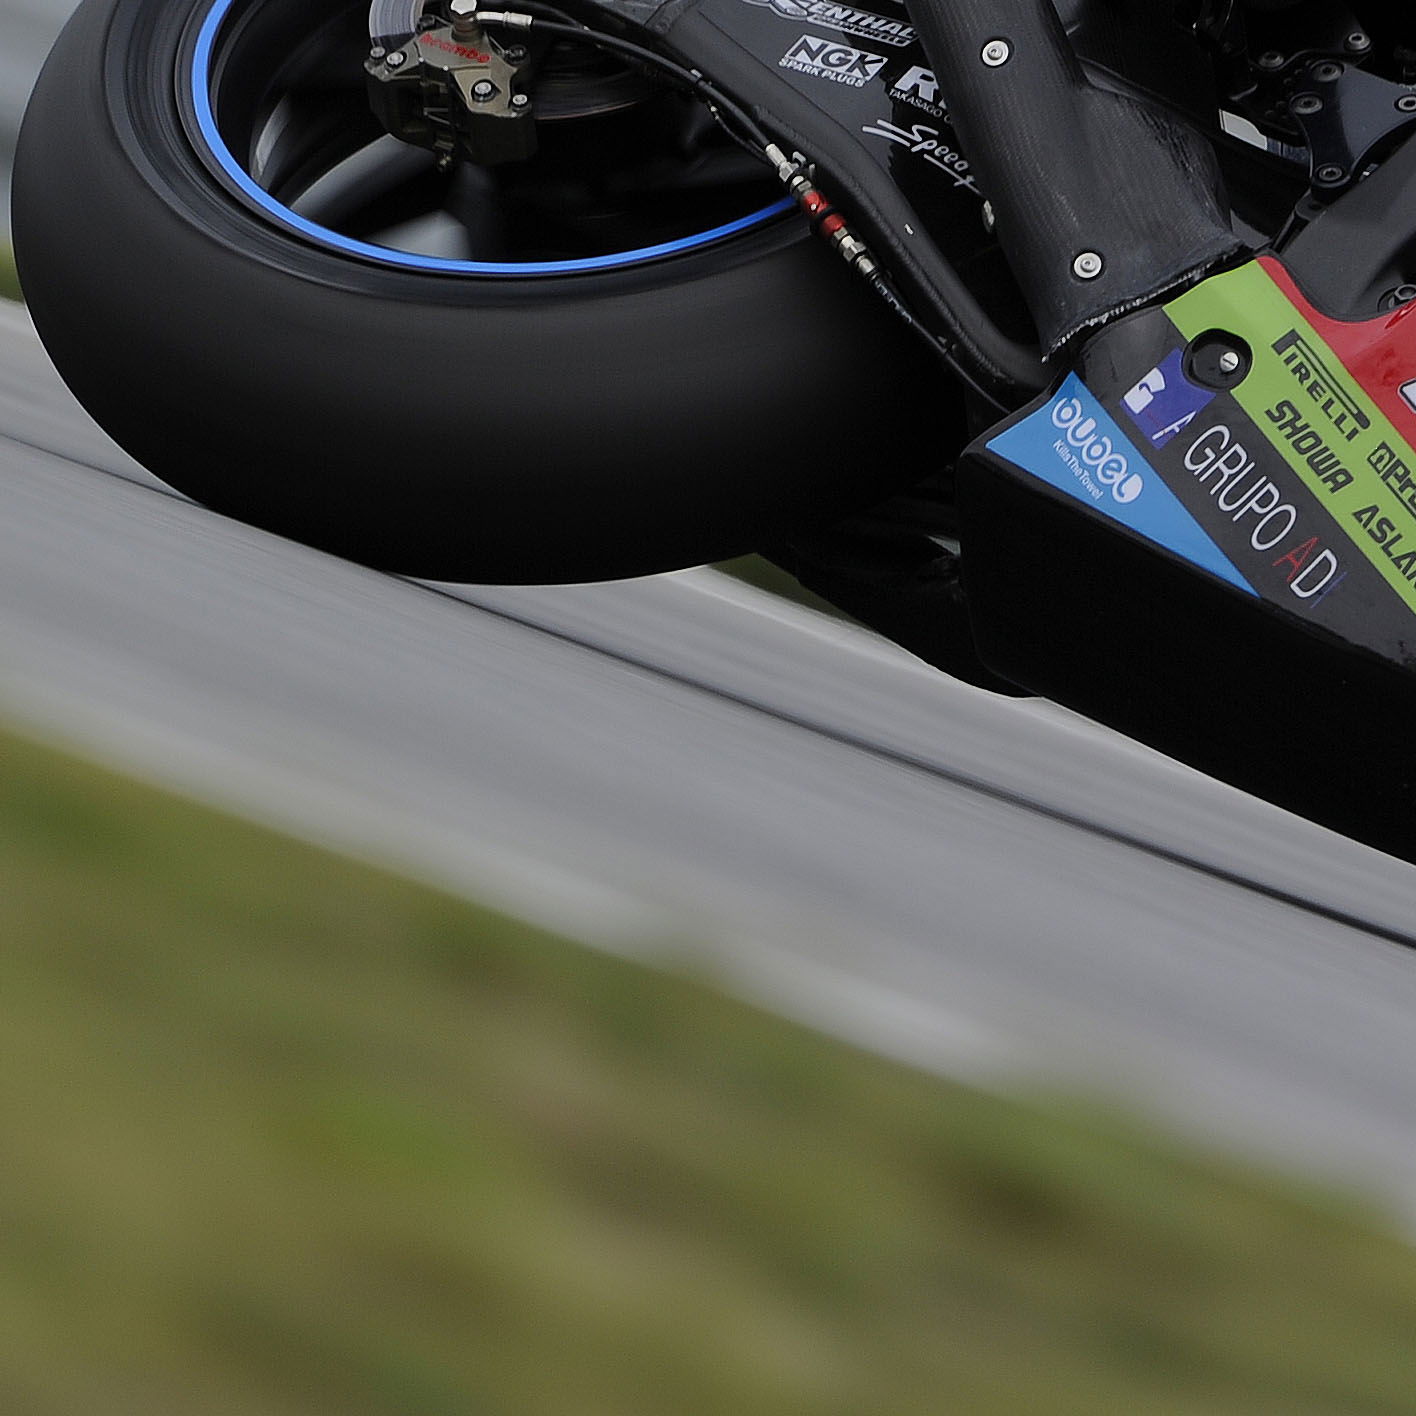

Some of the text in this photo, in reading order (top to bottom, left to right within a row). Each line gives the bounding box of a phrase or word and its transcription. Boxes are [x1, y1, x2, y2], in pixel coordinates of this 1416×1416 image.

[777, 57, 866, 89] SPARK PLUGS
[789, 37, 885, 78] NGK
[1271, 328, 1371, 442] PIRELLI
[1183, 425, 1297, 551] GRUPO
[1264, 399, 1355, 495] SHOWA
